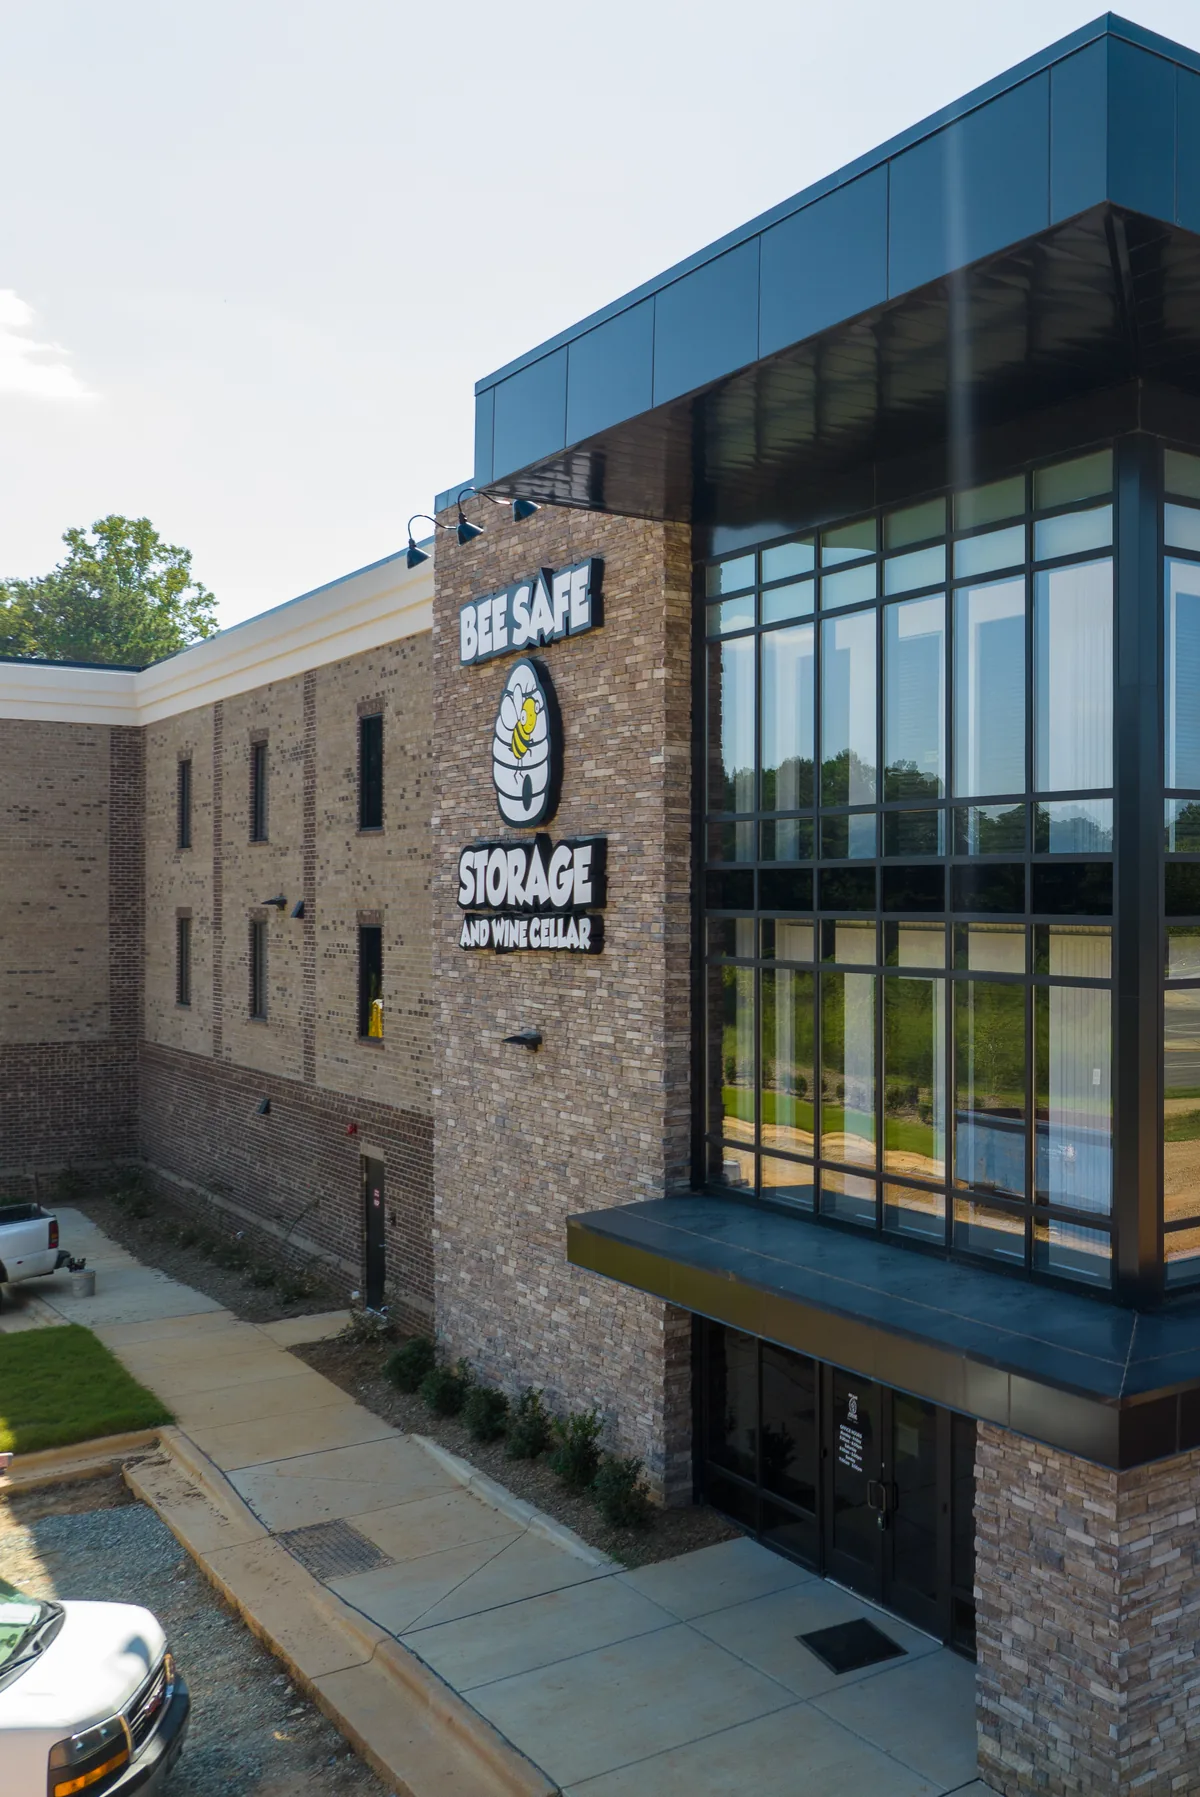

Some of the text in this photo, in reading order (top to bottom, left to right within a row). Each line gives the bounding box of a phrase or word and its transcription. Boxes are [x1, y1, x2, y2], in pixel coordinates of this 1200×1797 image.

[460, 565, 589, 661] BEE SAFE
[458, 844, 592, 907] STORAGE
[460, 916, 592, 950] AND WINE CELLAR
